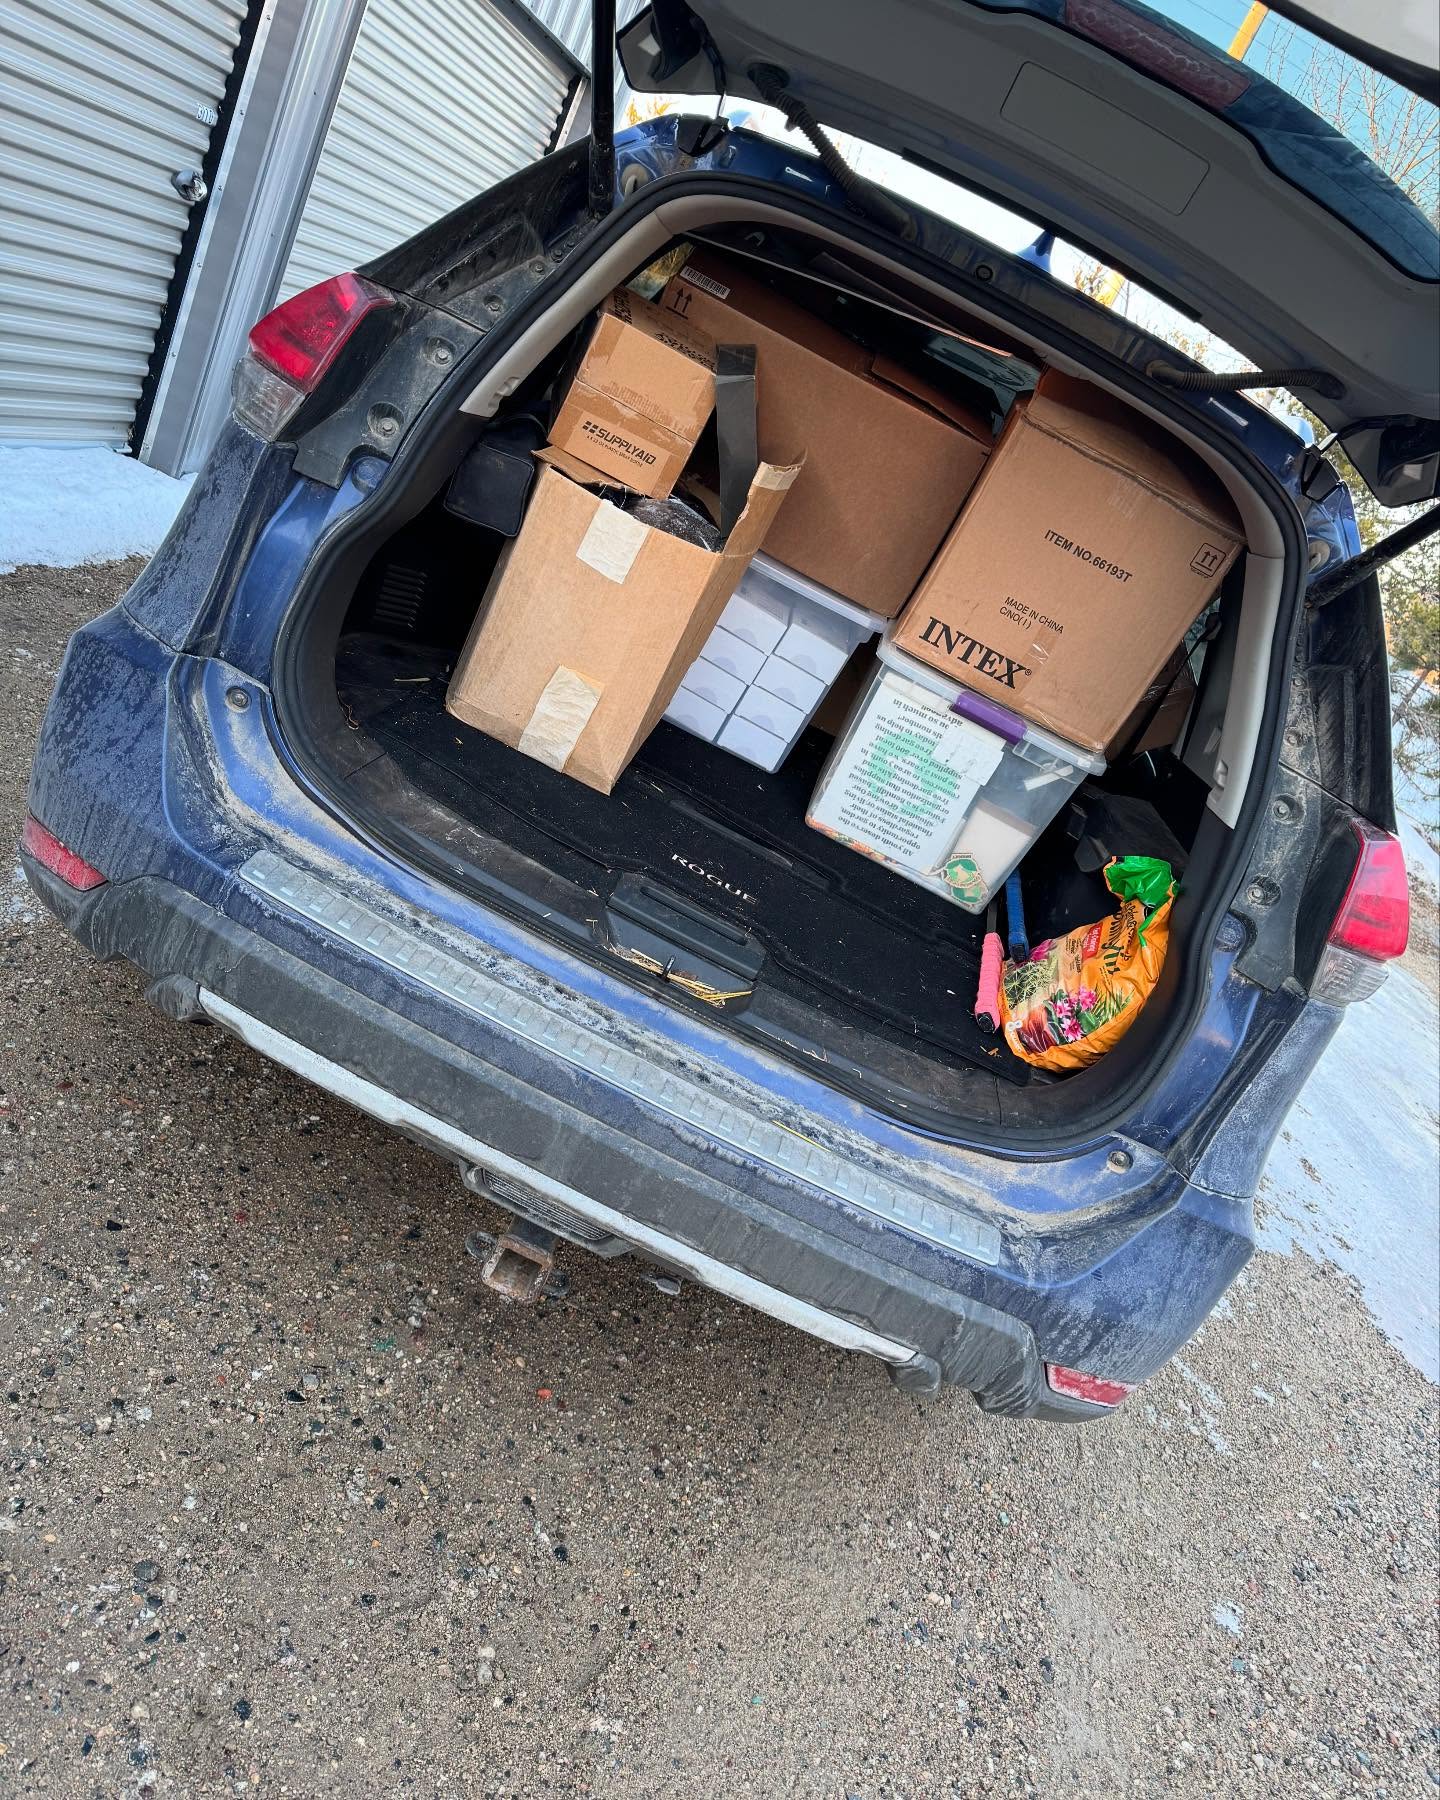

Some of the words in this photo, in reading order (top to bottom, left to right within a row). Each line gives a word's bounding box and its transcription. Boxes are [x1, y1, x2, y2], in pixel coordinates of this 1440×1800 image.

[596, 428, 657, 465] SUPPLYAID
[1044, 529, 1072, 552] ITEM
[1072, 545, 1133, 583] NO.66193T
[1004, 596, 1028, 617] MADE
[1029, 609, 1039, 621] IN
[1039, 614, 1064, 634] CHINA
[891, 698, 902, 708] in
[876, 713, 886, 721] us
[901, 703, 927, 720] much
[885, 718, 905, 732] help
[927, 715, 939, 724] so
[938, 720, 949, 730] ou
[873, 722, 916, 747] gardening
[904, 727, 913, 735] to
[912, 730, 936, 747] today
[866, 741, 888, 756] have
[874, 734, 895, 749] local
[859, 747, 869, 756] In
[886, 751, 899, 760] we
[894, 744, 910, 755] 500
[913, 743, 932, 756] free
[861, 758, 877, 770] and
[909, 751, 929, 764] over
[852, 763, 886, 784] supplies
[876, 766, 892, 778] kits
[892, 763, 911, 776] area
[910, 773, 920, 781] to
[927, 758, 963, 782] supplied
[929, 770, 948, 784] past
[848, 772, 872, 788] based
[884, 780, 901, 792] that
[891, 772, 932, 798] gardening
[946, 780, 960, 791] the
[851, 783, 866, 794] Our
[875, 785, 905, 804] Bemidji
[919, 777, 960, 800] resources
[843, 789, 865, 804] living
[865, 790, 899, 811] Growing
[900, 787, 950, 817] organization
[931, 793, 949, 806] free
[848, 802, 868, 816] their
[874, 805, 898, 820] status
[910, 803, 919, 811] is
[837, 815, 850, 825] the
[867, 811, 877, 820] of
[918, 807, 945, 824] Future
[849, 822, 880, 840] deserve
[876, 815, 919, 840] regardless
[897, 816, 932, 837] financial
[876, 823, 921, 851] opportunity
[880, 836, 903, 851] youth
[672, 853, 757, 904] ROGUE
